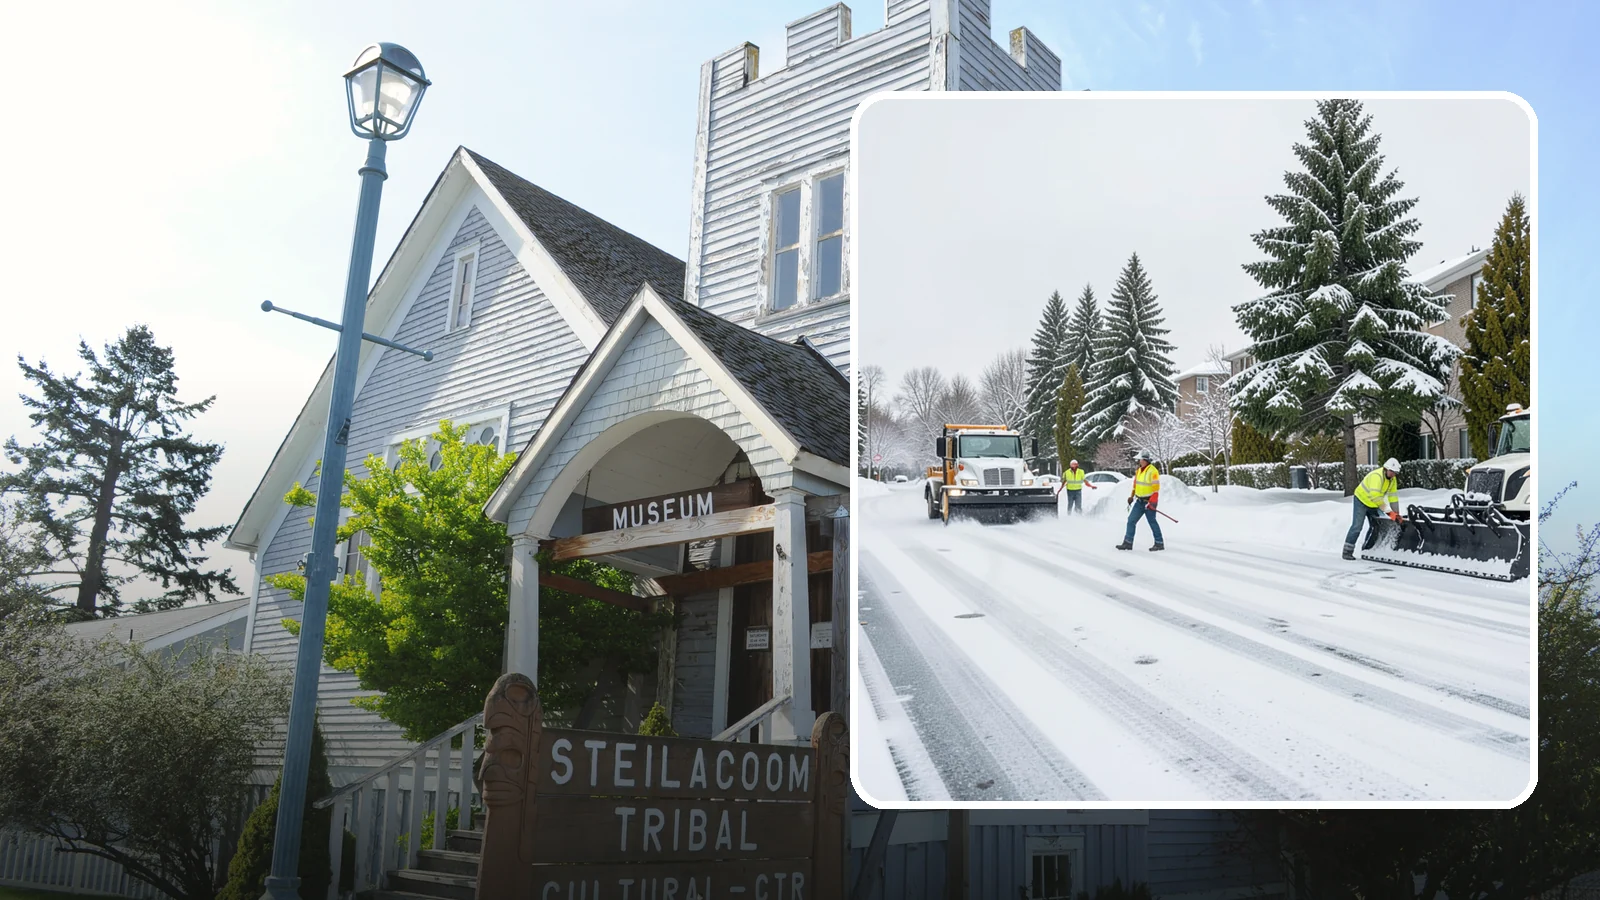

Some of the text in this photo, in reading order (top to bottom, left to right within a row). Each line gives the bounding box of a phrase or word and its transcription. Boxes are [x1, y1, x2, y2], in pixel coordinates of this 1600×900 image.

[613, 491, 714, 531] MUSEUM
[550, 738, 810, 792] STEILACOOM
[614, 806, 758, 852] TRIBAL
